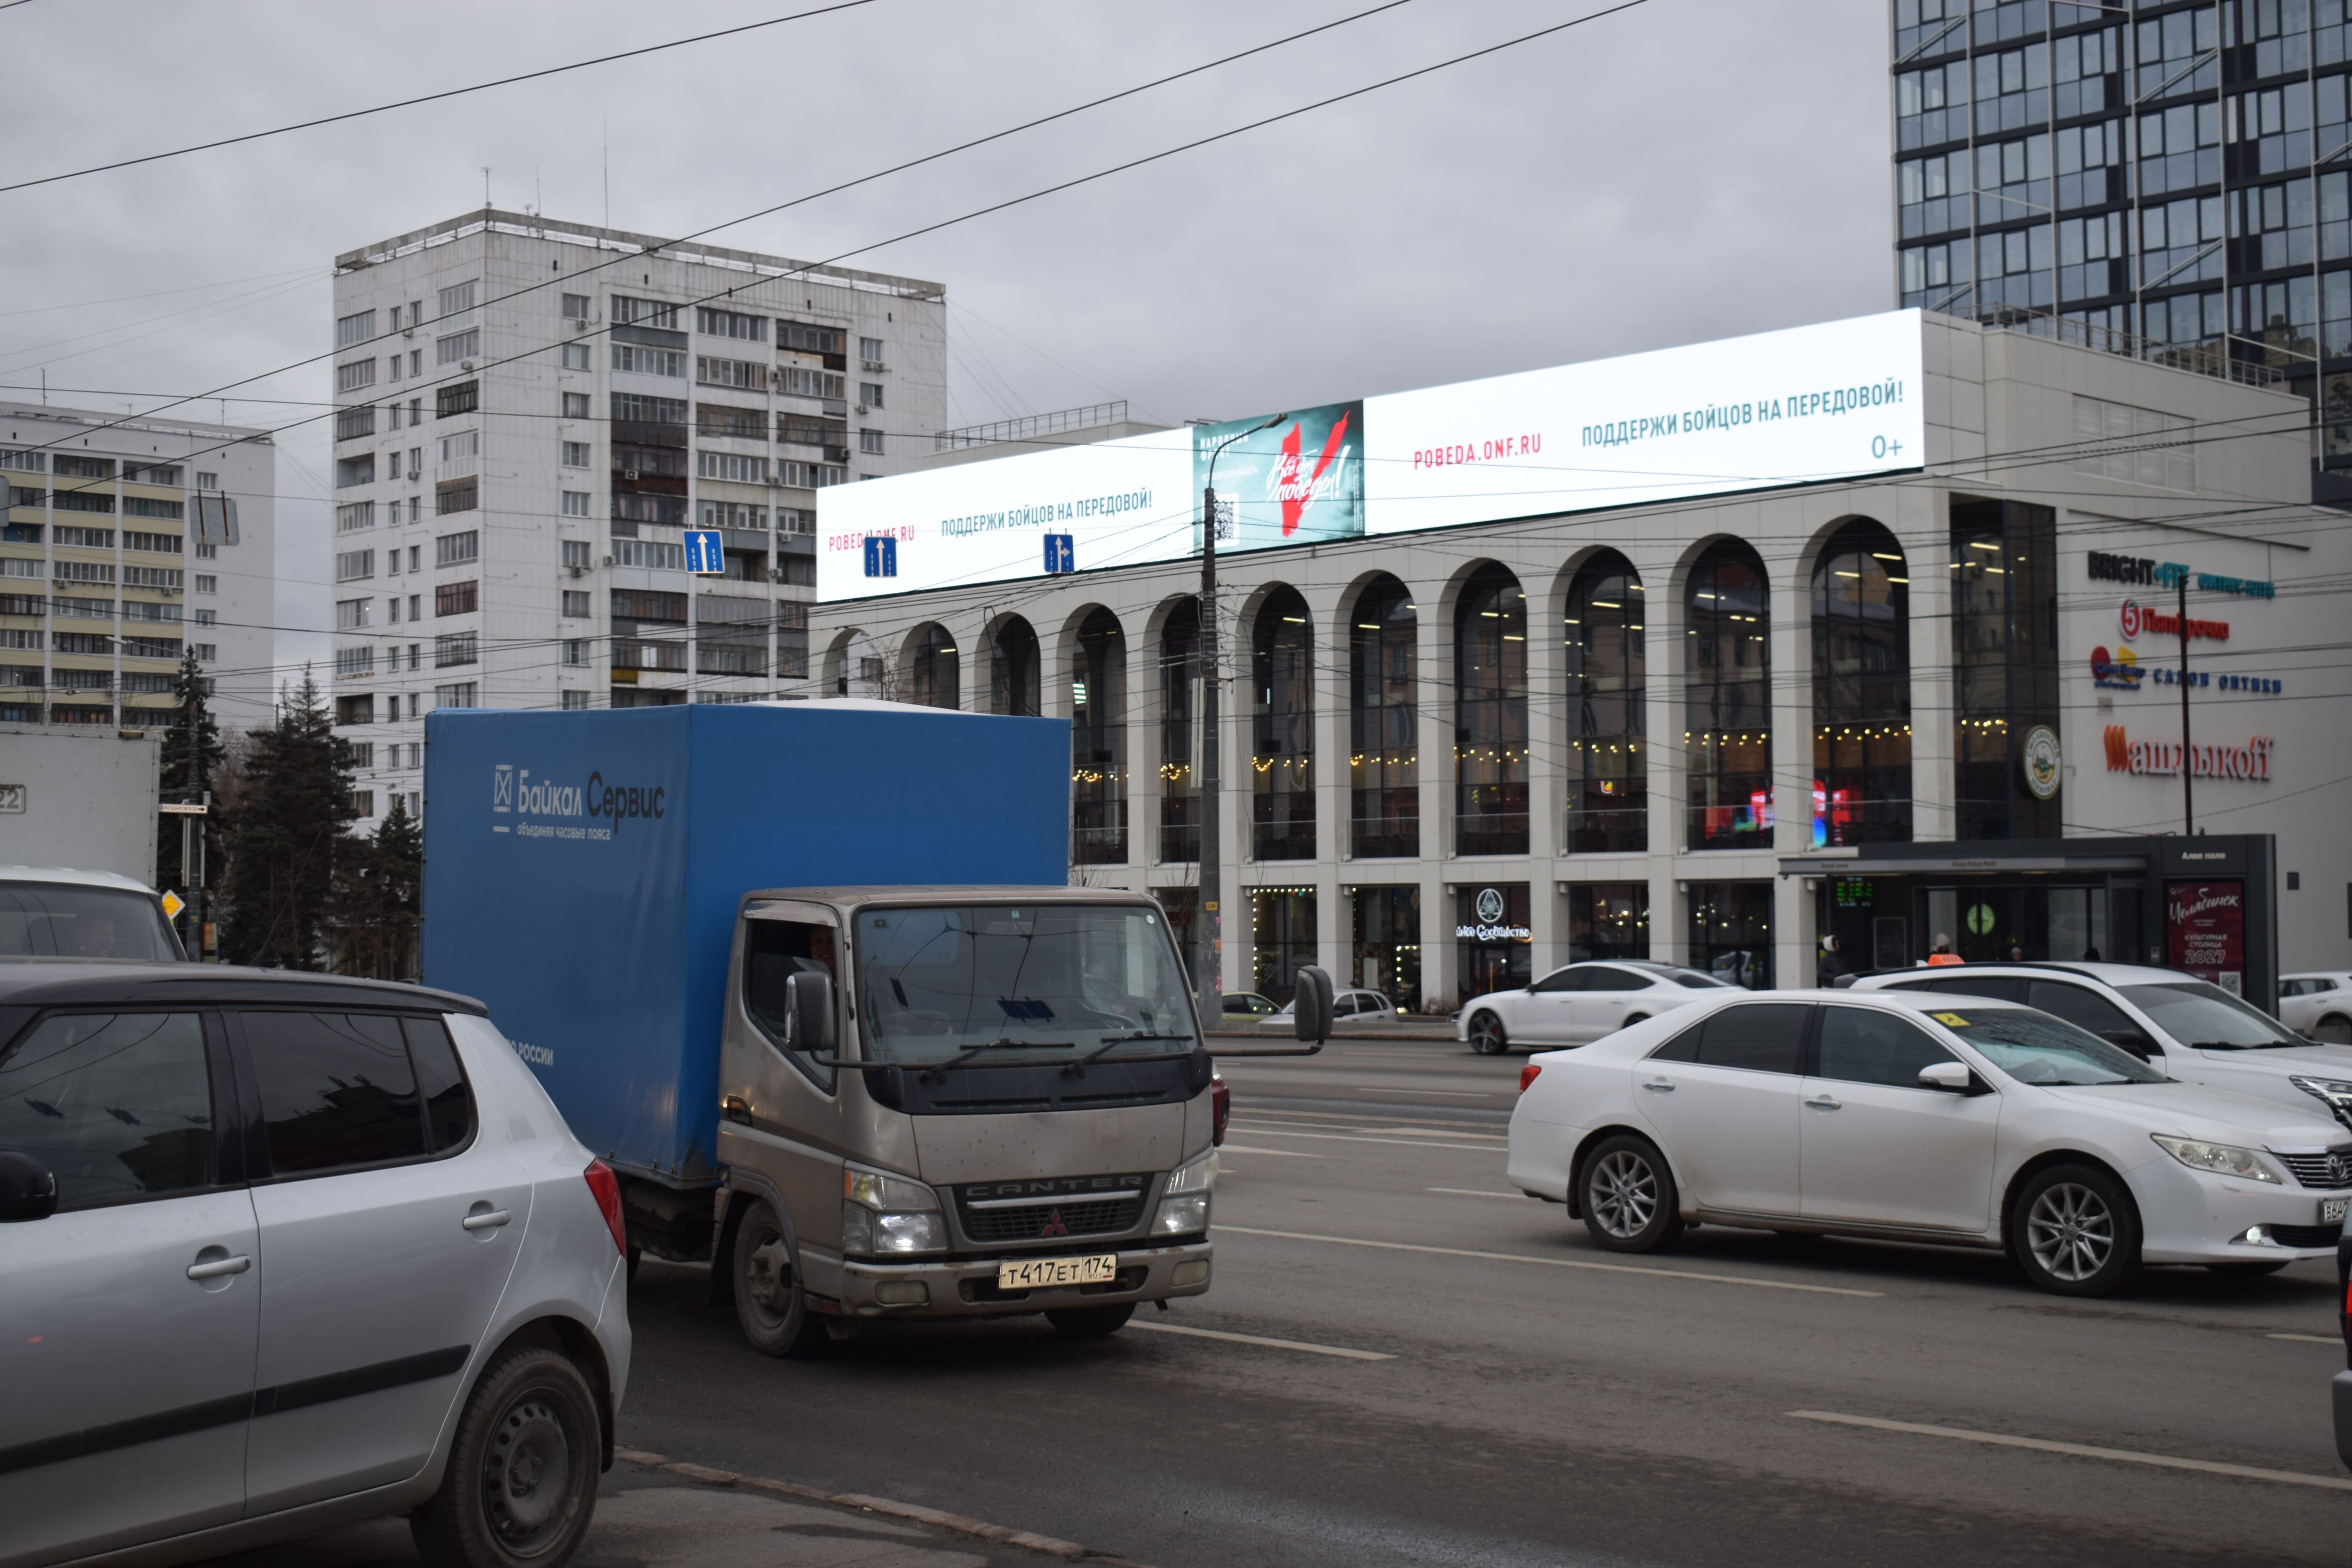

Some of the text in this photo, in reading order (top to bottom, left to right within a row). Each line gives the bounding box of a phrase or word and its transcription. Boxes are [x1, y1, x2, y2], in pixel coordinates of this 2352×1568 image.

[1582, 377, 1903, 448] ПОДДЕРЖИ БОЙЦОВ НА ПЕРЕДОВОЙ!
[1415, 434, 1540, 470] POBEDA.ONF.RU
[942, 487, 1152, 537] ПОДДЕРЖИ БОЙЦОВ НА ПЕРЕДОВОЙ!
[2088, 551, 2155, 586] BRIGHT
[2142, 608, 2229, 642] Пятрочка
[2219, 675, 2281, 693] ОПТИКИ
[518, 770, 665, 834] Байкал Сервис
[517, 822, 611, 840] объединяя часовые пояса
[2185, 949, 2226, 964] 2027
[519, 1042, 554, 1066] РОССИИ
[966, 1177, 1143, 1196] CANTER
[1008, 1257, 1110, 1285] Т417ЕТ 174
